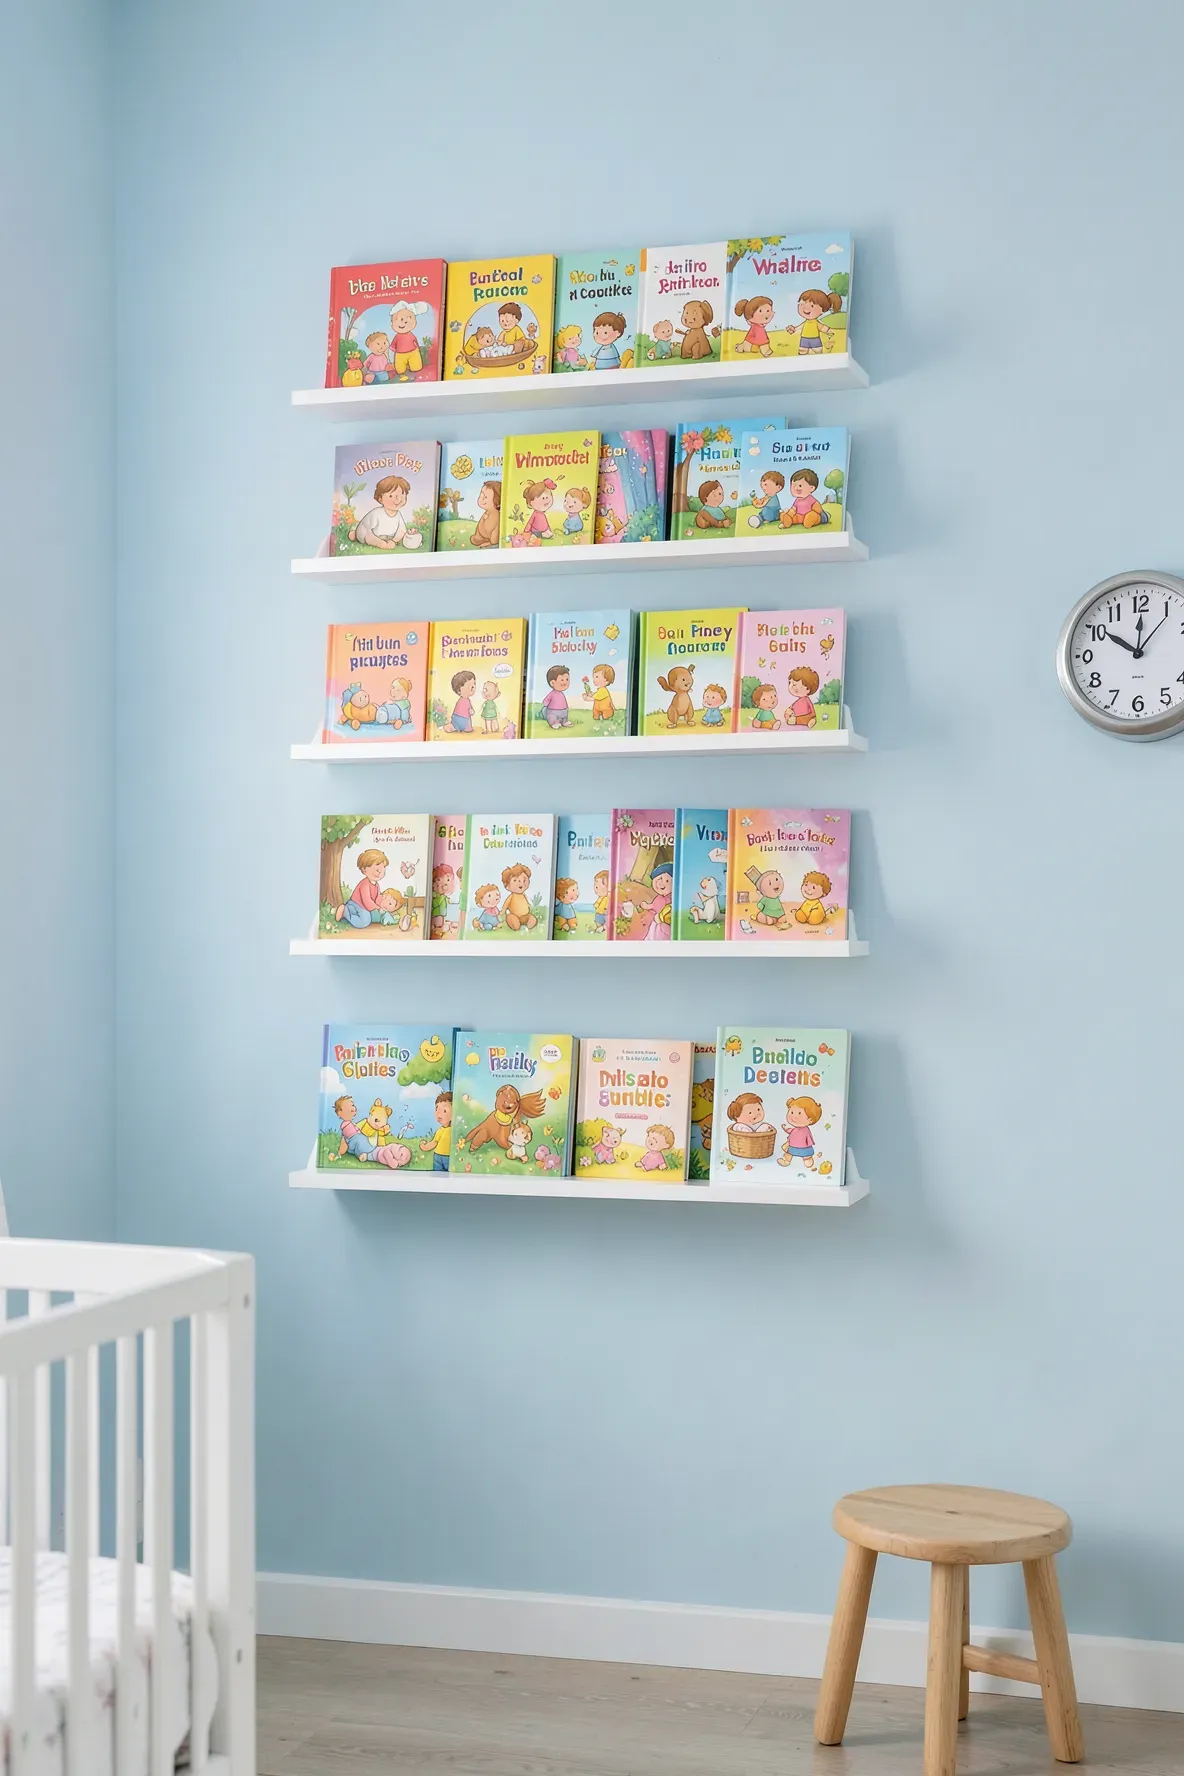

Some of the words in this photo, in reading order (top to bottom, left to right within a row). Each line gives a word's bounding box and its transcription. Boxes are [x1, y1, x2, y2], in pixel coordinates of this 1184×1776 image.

[1106, 603, 1121, 623] 11
[1132, 594, 1150, 614] 12
[1164, 601, 1169, 617] 1
[1090, 623, 1107, 642] 10
[1089, 671, 1102, 688] 8
[1109, 689, 1120, 706] 7
[1131, 695, 1145, 713] 6
[1160, 687, 1172, 706] 5
